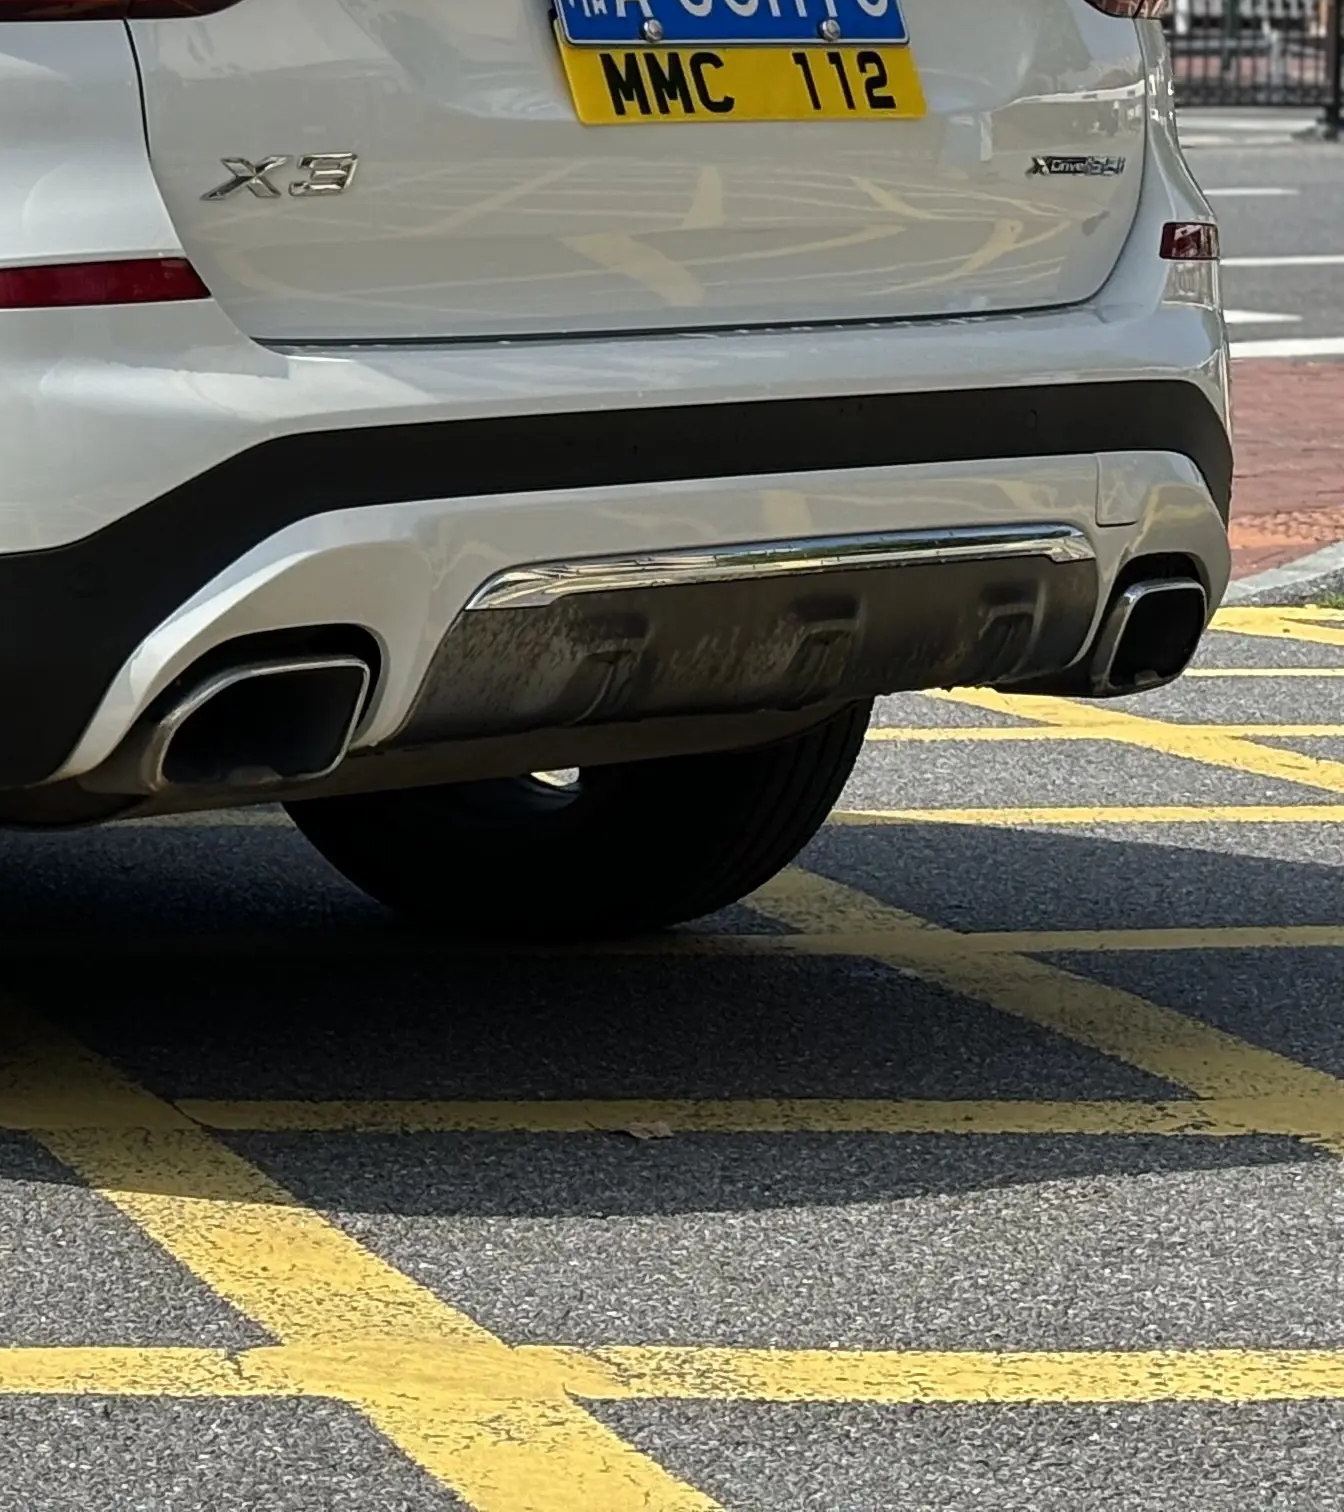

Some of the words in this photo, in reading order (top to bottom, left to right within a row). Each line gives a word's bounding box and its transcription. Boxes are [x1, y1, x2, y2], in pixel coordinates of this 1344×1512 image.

[600, 51, 734, 115] MMC
[793, 50, 896, 110] 112
[199, 152, 358, 201] X3
